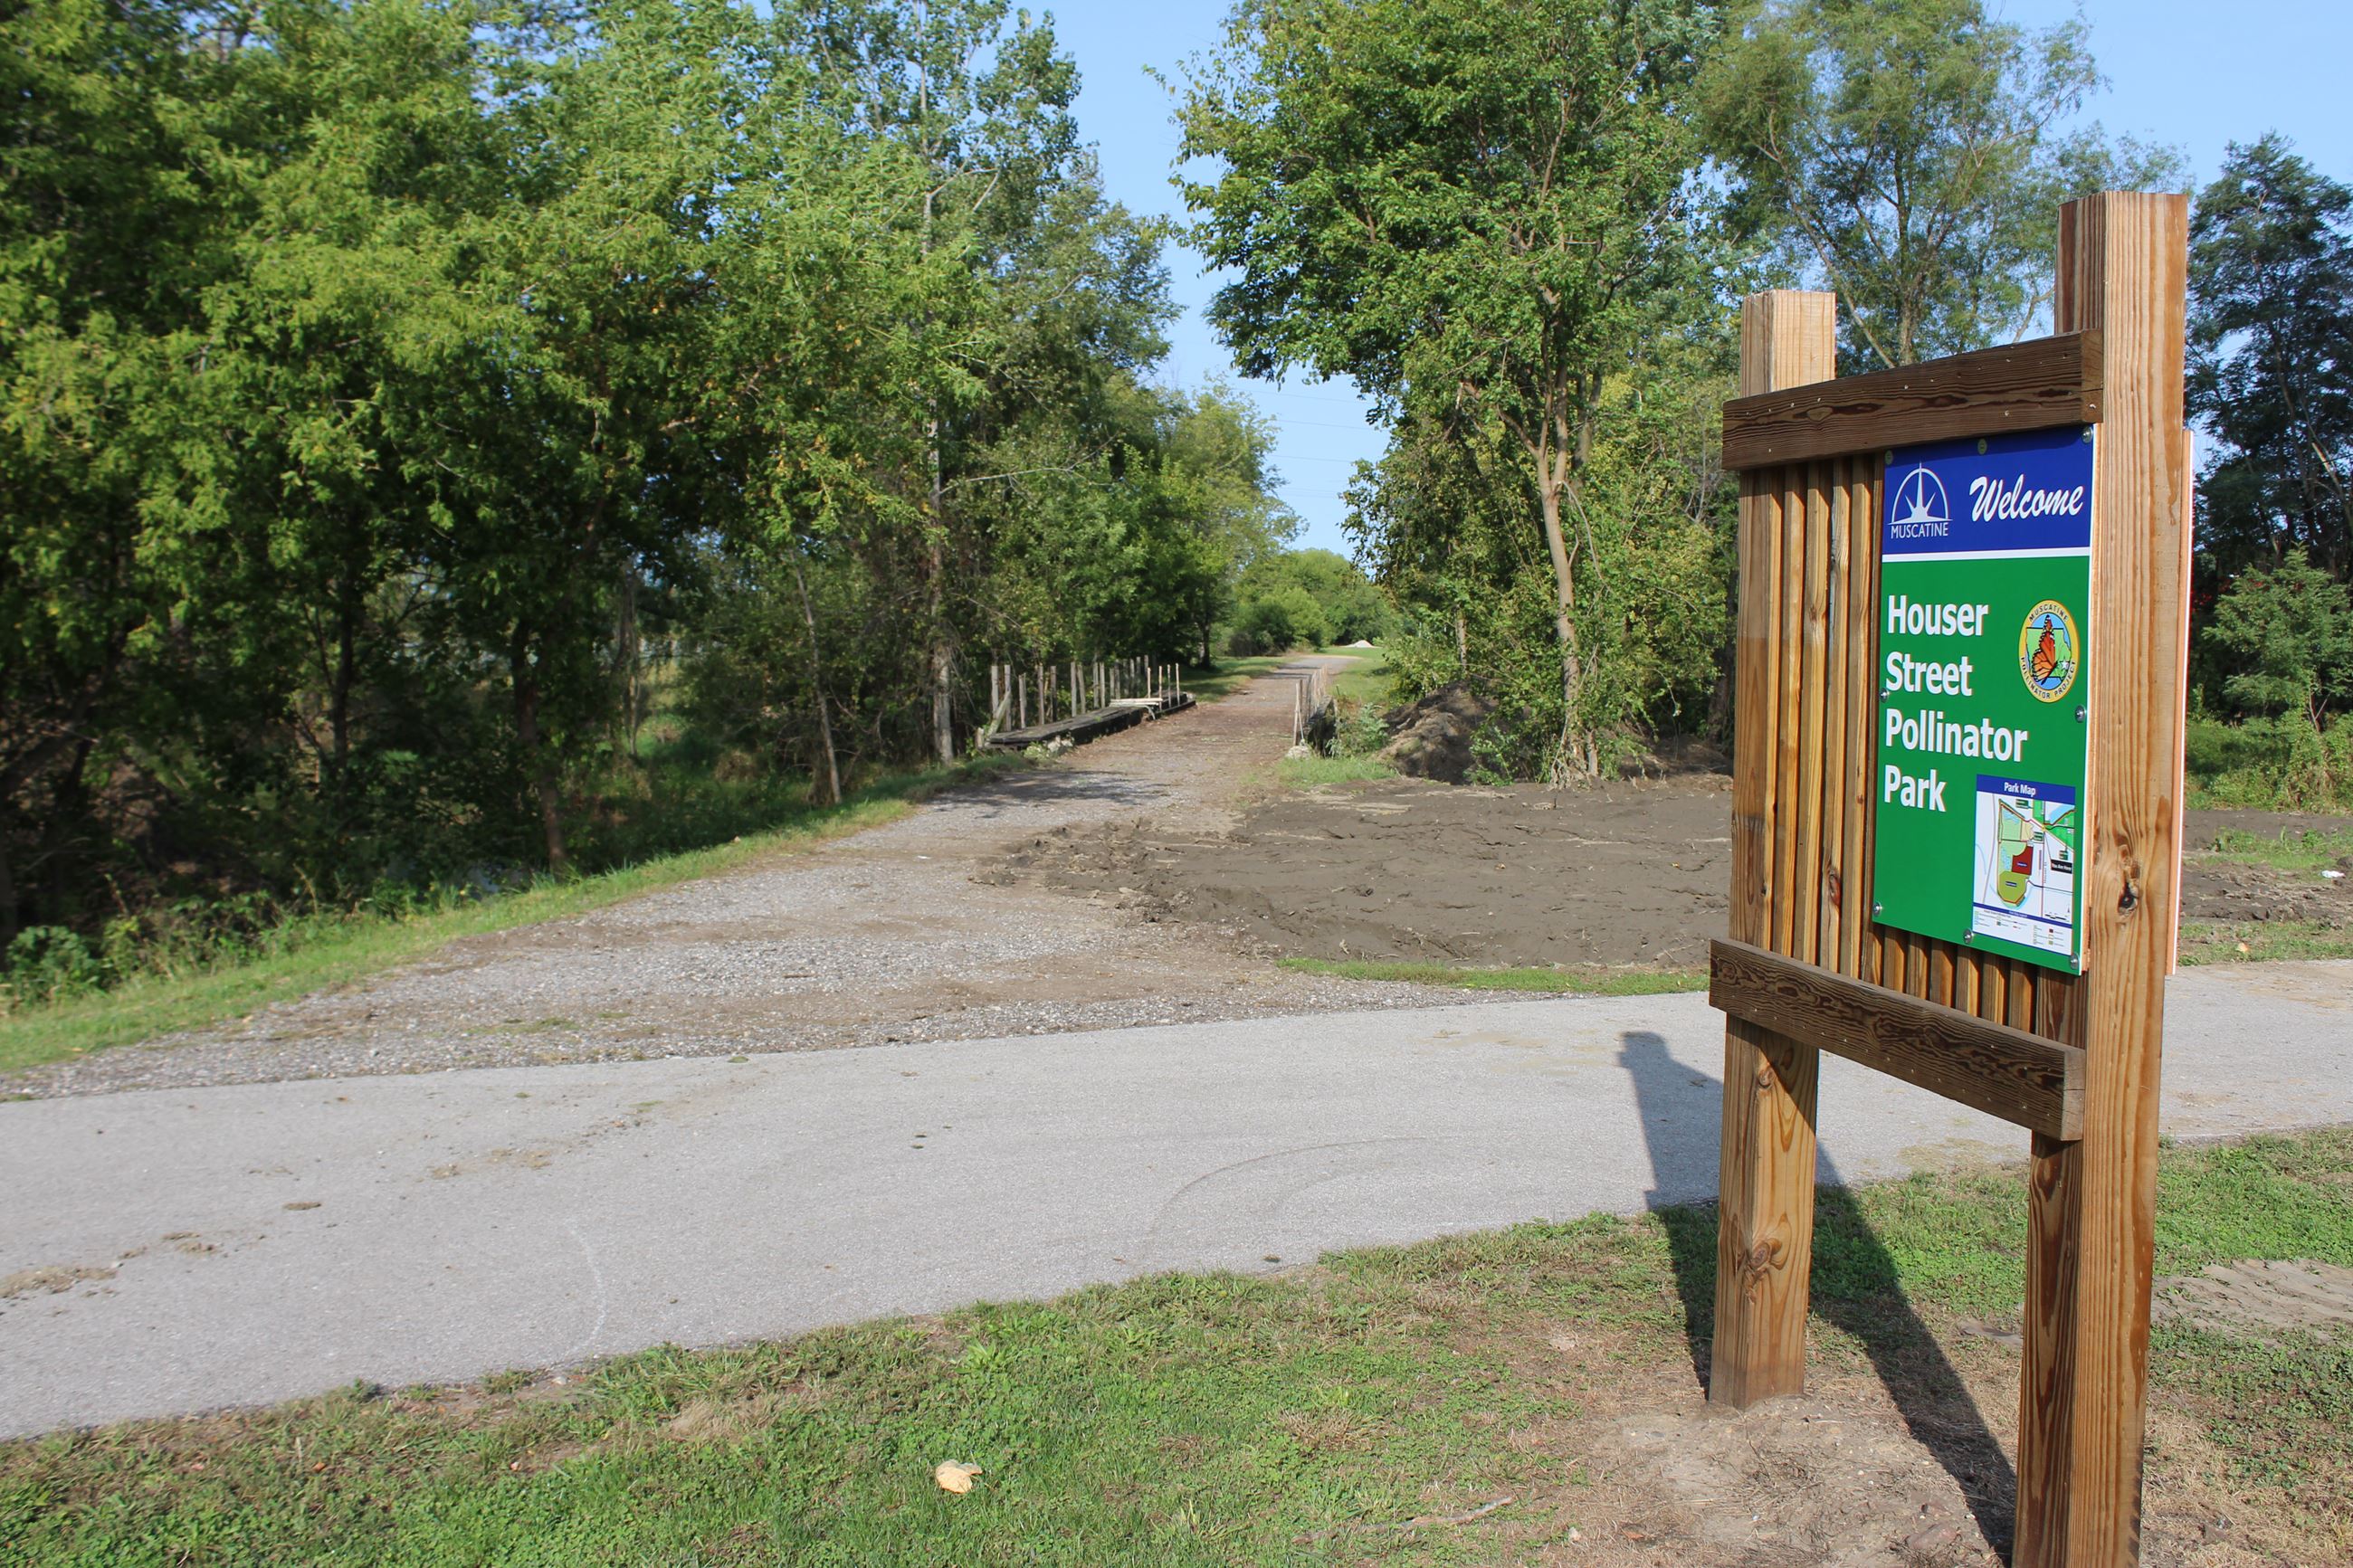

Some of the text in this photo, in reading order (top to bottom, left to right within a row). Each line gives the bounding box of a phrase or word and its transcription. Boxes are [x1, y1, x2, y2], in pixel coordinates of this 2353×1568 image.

[1969, 473, 2084, 522] Welcome
[1891, 521, 1948, 539] MUSCATINE
[1888, 594, 1989, 636] Houser
[2029, 603, 2069, 622] MUSCATINE
[1885, 651, 1973, 696] Street
[2020, 657, 2076, 699] POLLINATOR PROJECT
[1885, 708, 2028, 762] Pollinator
[1884, 765, 1948, 813] Park
[2004, 782, 2036, 797] Park Map
